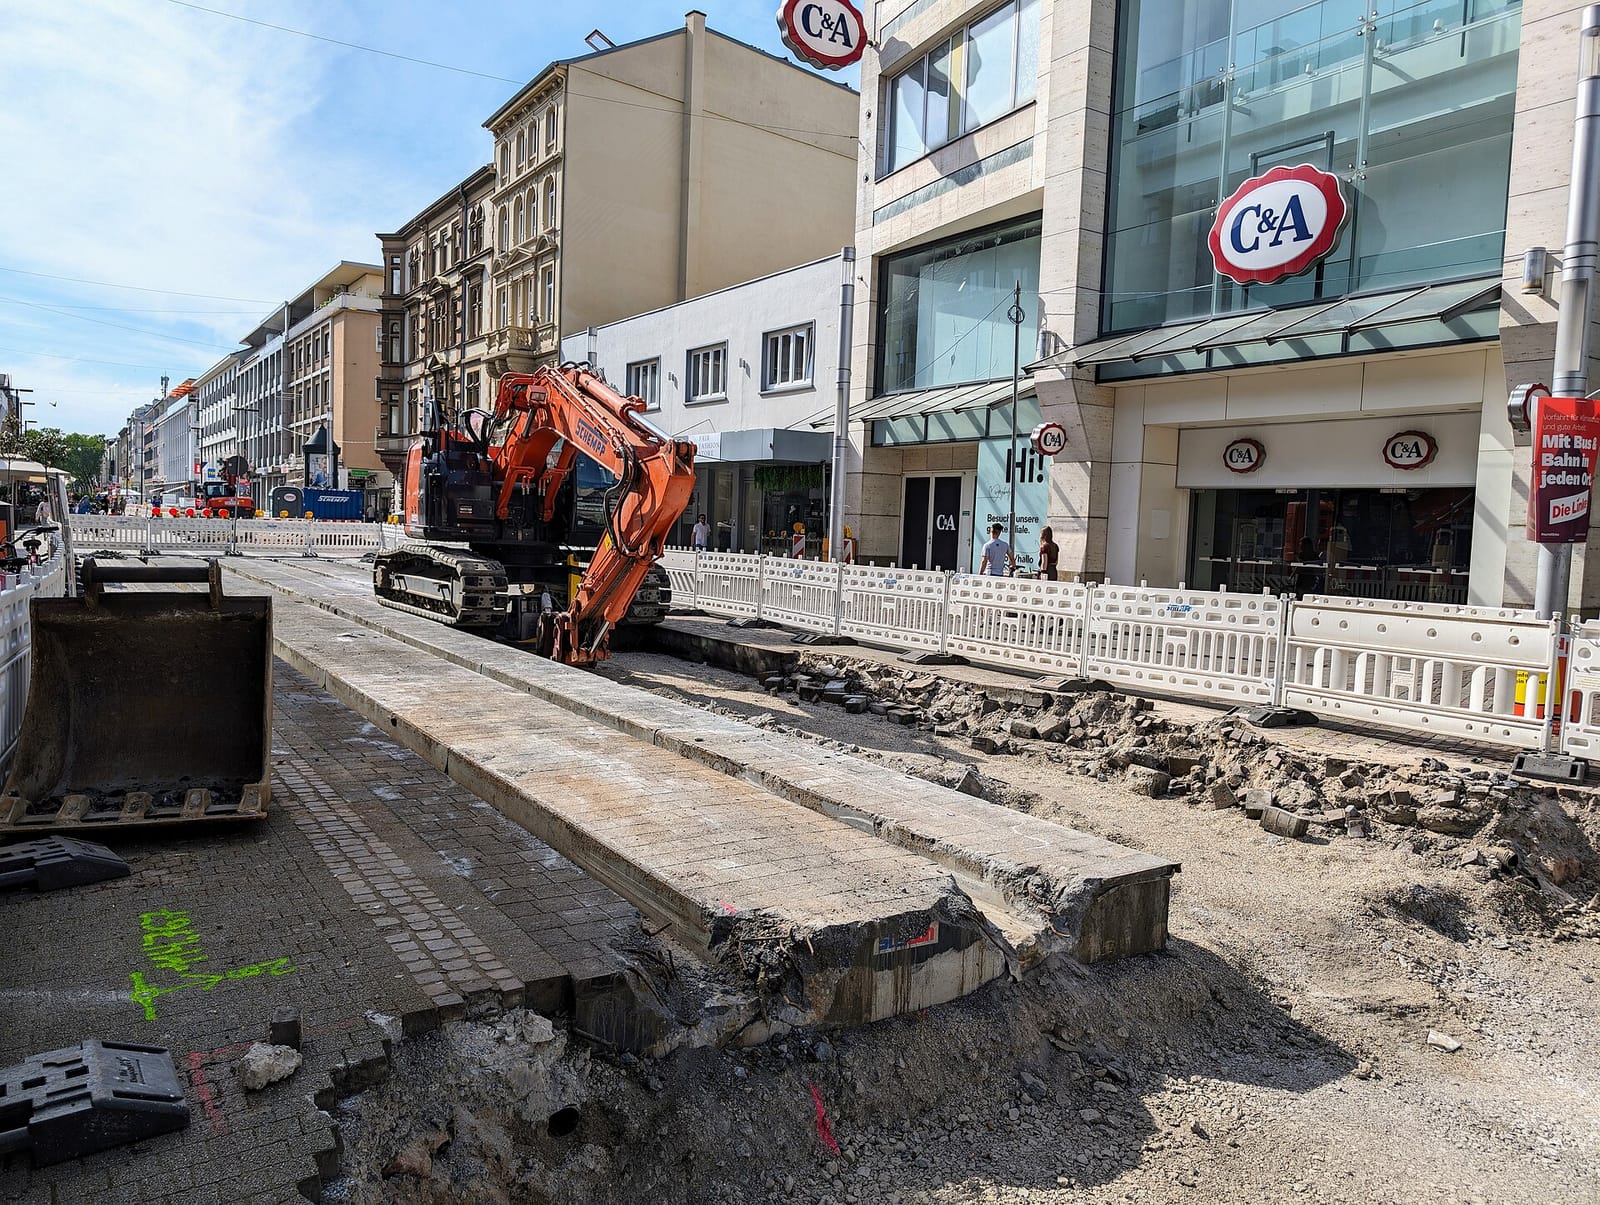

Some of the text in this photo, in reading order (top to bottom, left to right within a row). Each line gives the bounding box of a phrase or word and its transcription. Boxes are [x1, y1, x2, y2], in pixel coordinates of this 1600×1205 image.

[801, 3, 853, 49] C&A
[1230, 194, 1314, 254] C&A
[575, 421, 607, 456] SCHEMPP
[1043, 432, 1062, 447] C&A
[1542, 434, 1571, 449] Mit
[1574, 435, 1592, 450] Bus
[1228, 448, 1254, 464] C&A
[1389, 441, 1424, 459] C&A
[1005, 447, 1044, 484] Hi!
[1541, 452, 1589, 468] Bahn in
[1540, 470, 1580, 488] jeden
[1015, 515, 1039, 524] unsere
[1552, 504, 1571, 519] Die
[936, 514, 957, 531] C&A
